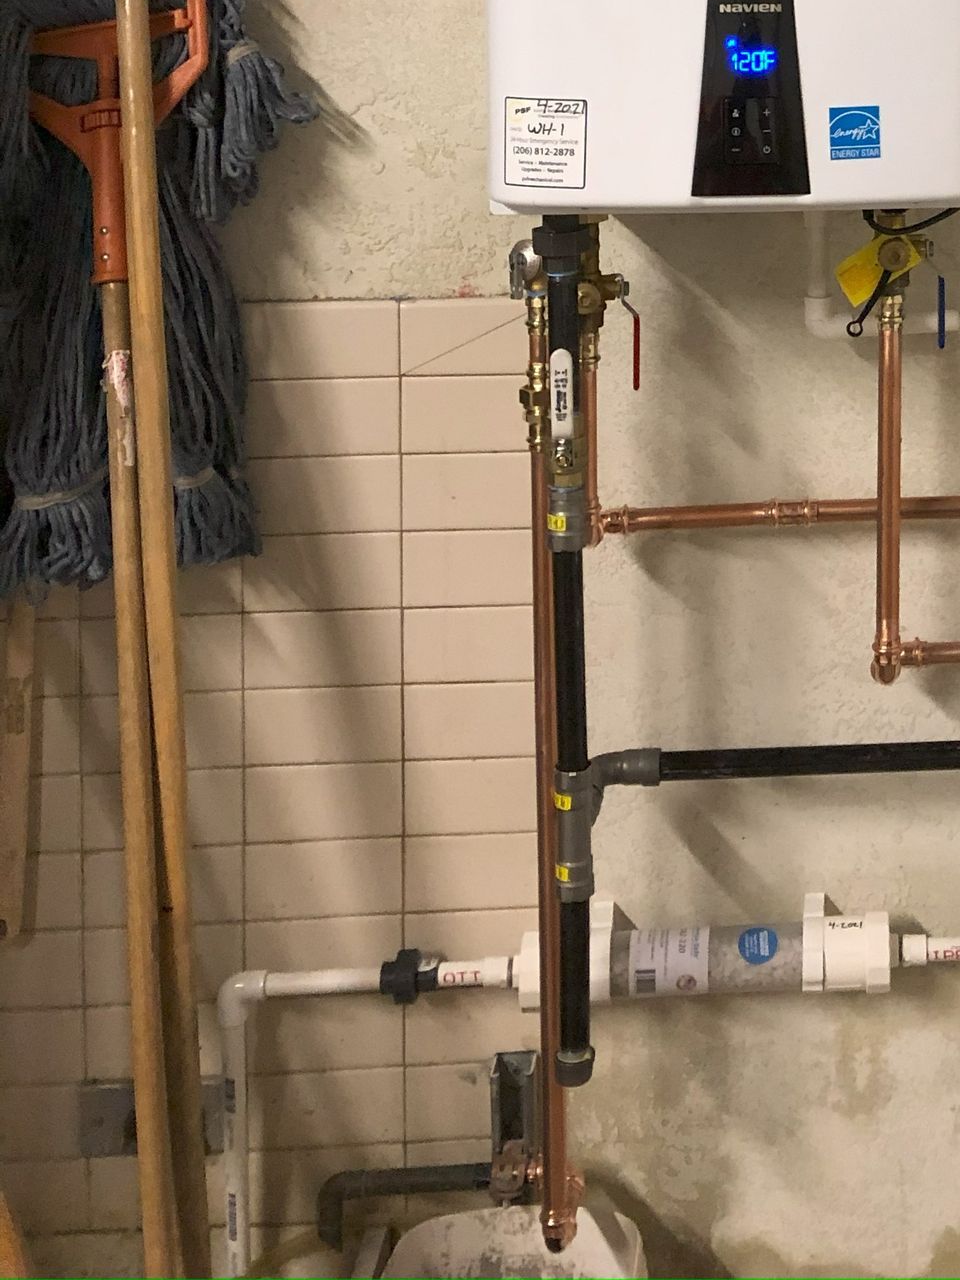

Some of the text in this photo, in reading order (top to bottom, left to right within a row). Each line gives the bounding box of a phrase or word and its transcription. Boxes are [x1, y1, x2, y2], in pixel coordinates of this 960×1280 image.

[515, 106, 531, 115] PSF
[513, 146, 575, 157] (206) 812-2878
[831, 147, 879, 158] ENERGY STAR
